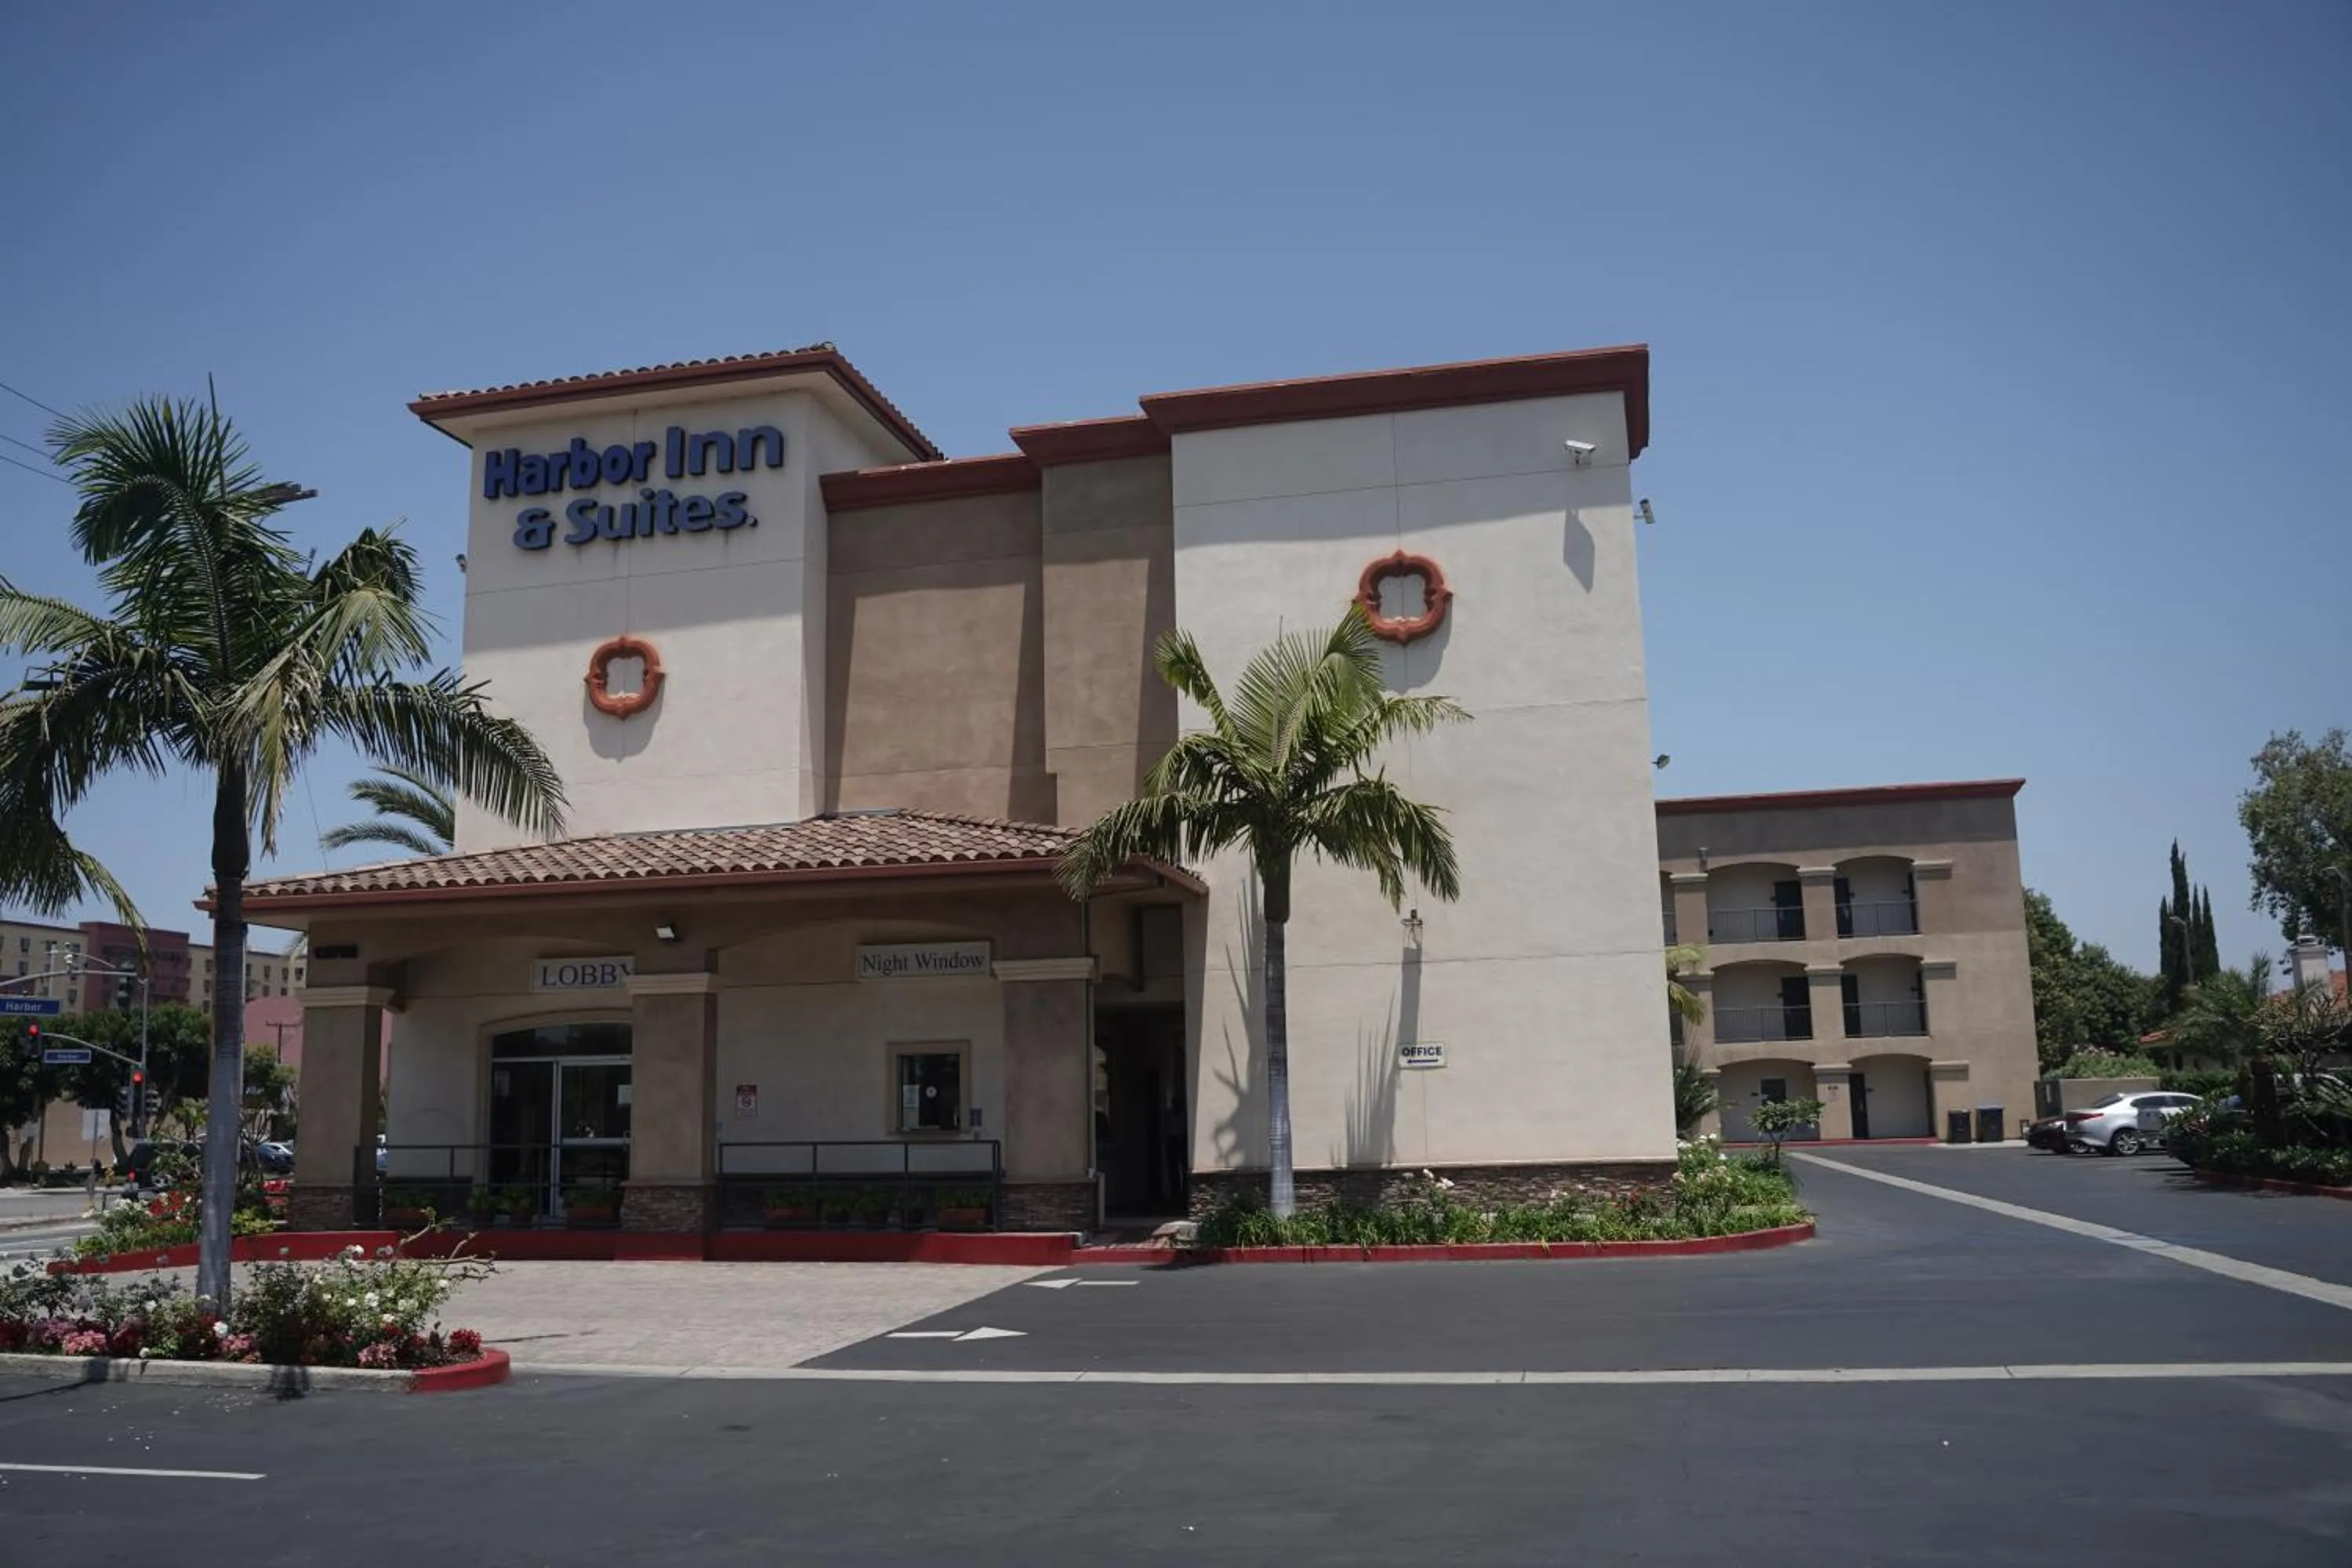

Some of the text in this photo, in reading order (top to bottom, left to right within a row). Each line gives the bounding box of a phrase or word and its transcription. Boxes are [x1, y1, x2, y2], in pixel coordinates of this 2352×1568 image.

[484, 426, 784, 500] Harbor Inn
[513, 506, 556, 550] &
[863, 951, 985, 976] Night Window
[5, 1000, 42, 1011] Harbor
[1402, 1045, 1443, 1057] OFFICE
